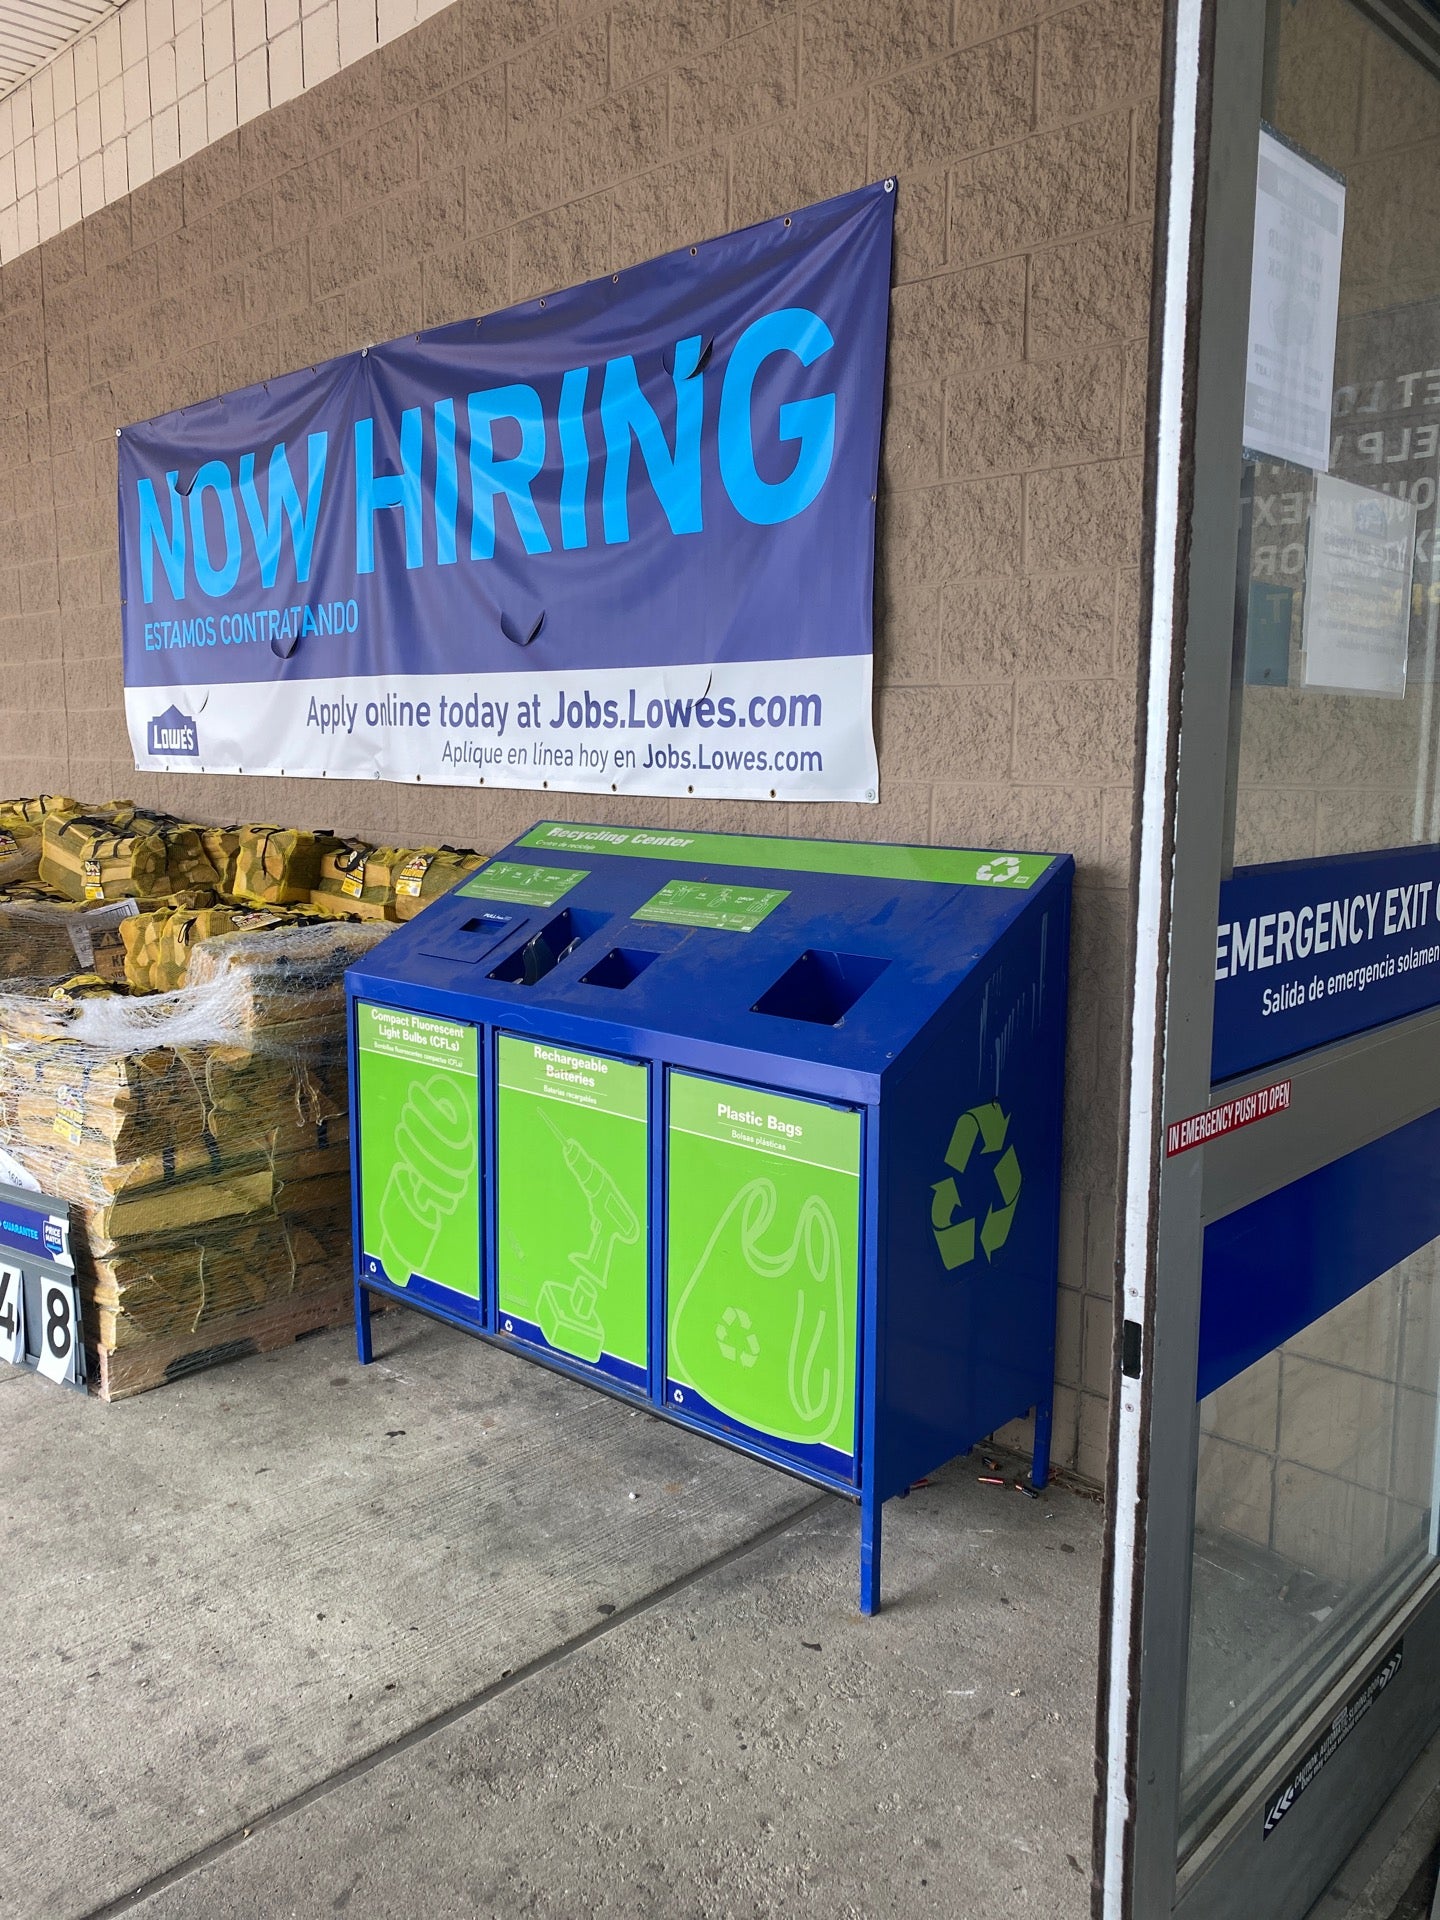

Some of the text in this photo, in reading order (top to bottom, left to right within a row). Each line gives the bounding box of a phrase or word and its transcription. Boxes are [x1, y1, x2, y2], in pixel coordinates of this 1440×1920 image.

[137, 307, 836, 604] NOW HIRING
[144, 599, 359, 651] ESTAMOS CONTRATANDO
[307, 689, 822, 736] Apply online today at Jobs.Lowes.com
[442, 740, 823, 773] Aplique en línea hoy en Jobs.Lowes.com
[547, 827, 695, 848] Recycling Center
[1215, 892, 1381, 980] EMERGENCY
[1384, 881, 1433, 936] EXIT
[1262, 945, 1440, 1016] Salida de emergencia solamen
[371, 1008, 464, 1038] Compact Fluorescent
[379, 1024, 460, 1052] Light Bulbs (CFLs)
[533, 1046, 608, 1074] Rechargeable
[546, 1064, 595, 1087] Batteries
[717, 1103, 803, 1137] Plastic Bags
[1168, 1082, 1290, 1152] IN EMERGENCY PUSH TO OPEN
[731, 1129, 755, 1143] Bolsas
[2, 1220, 39, 1240] GUARANTEE
[45, 1225, 61, 1238] PRICE
